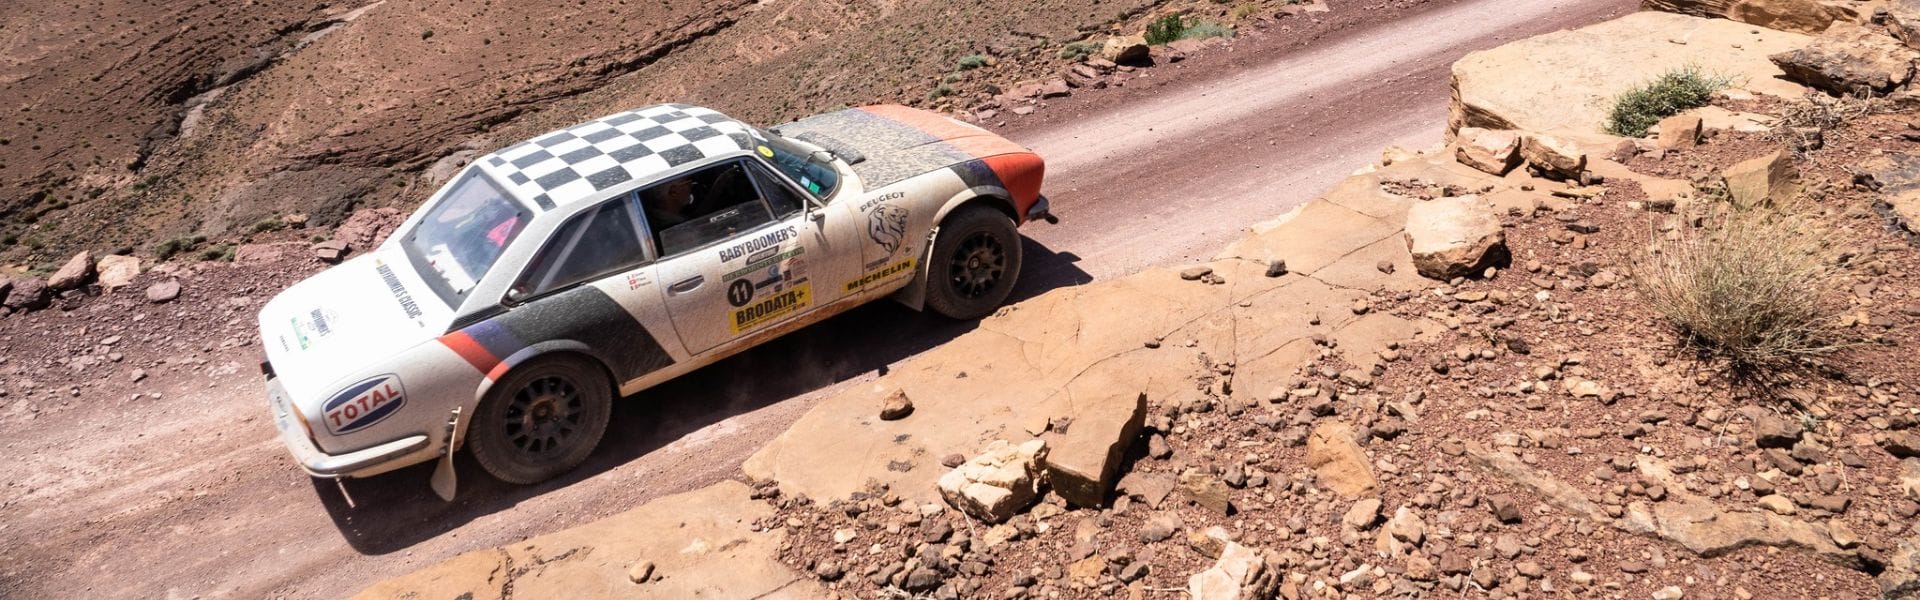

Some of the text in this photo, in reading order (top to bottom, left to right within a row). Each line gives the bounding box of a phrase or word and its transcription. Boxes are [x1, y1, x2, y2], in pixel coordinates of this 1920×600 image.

[860, 191, 905, 212] PEUGEOT
[719, 225, 797, 262] BABYBOOMER'S
[847, 260, 911, 291] MICHELIN
[401, 290, 423, 319] CLASSIC
[732, 284, 750, 302] 11
[329, 384, 399, 427] TOTAL
